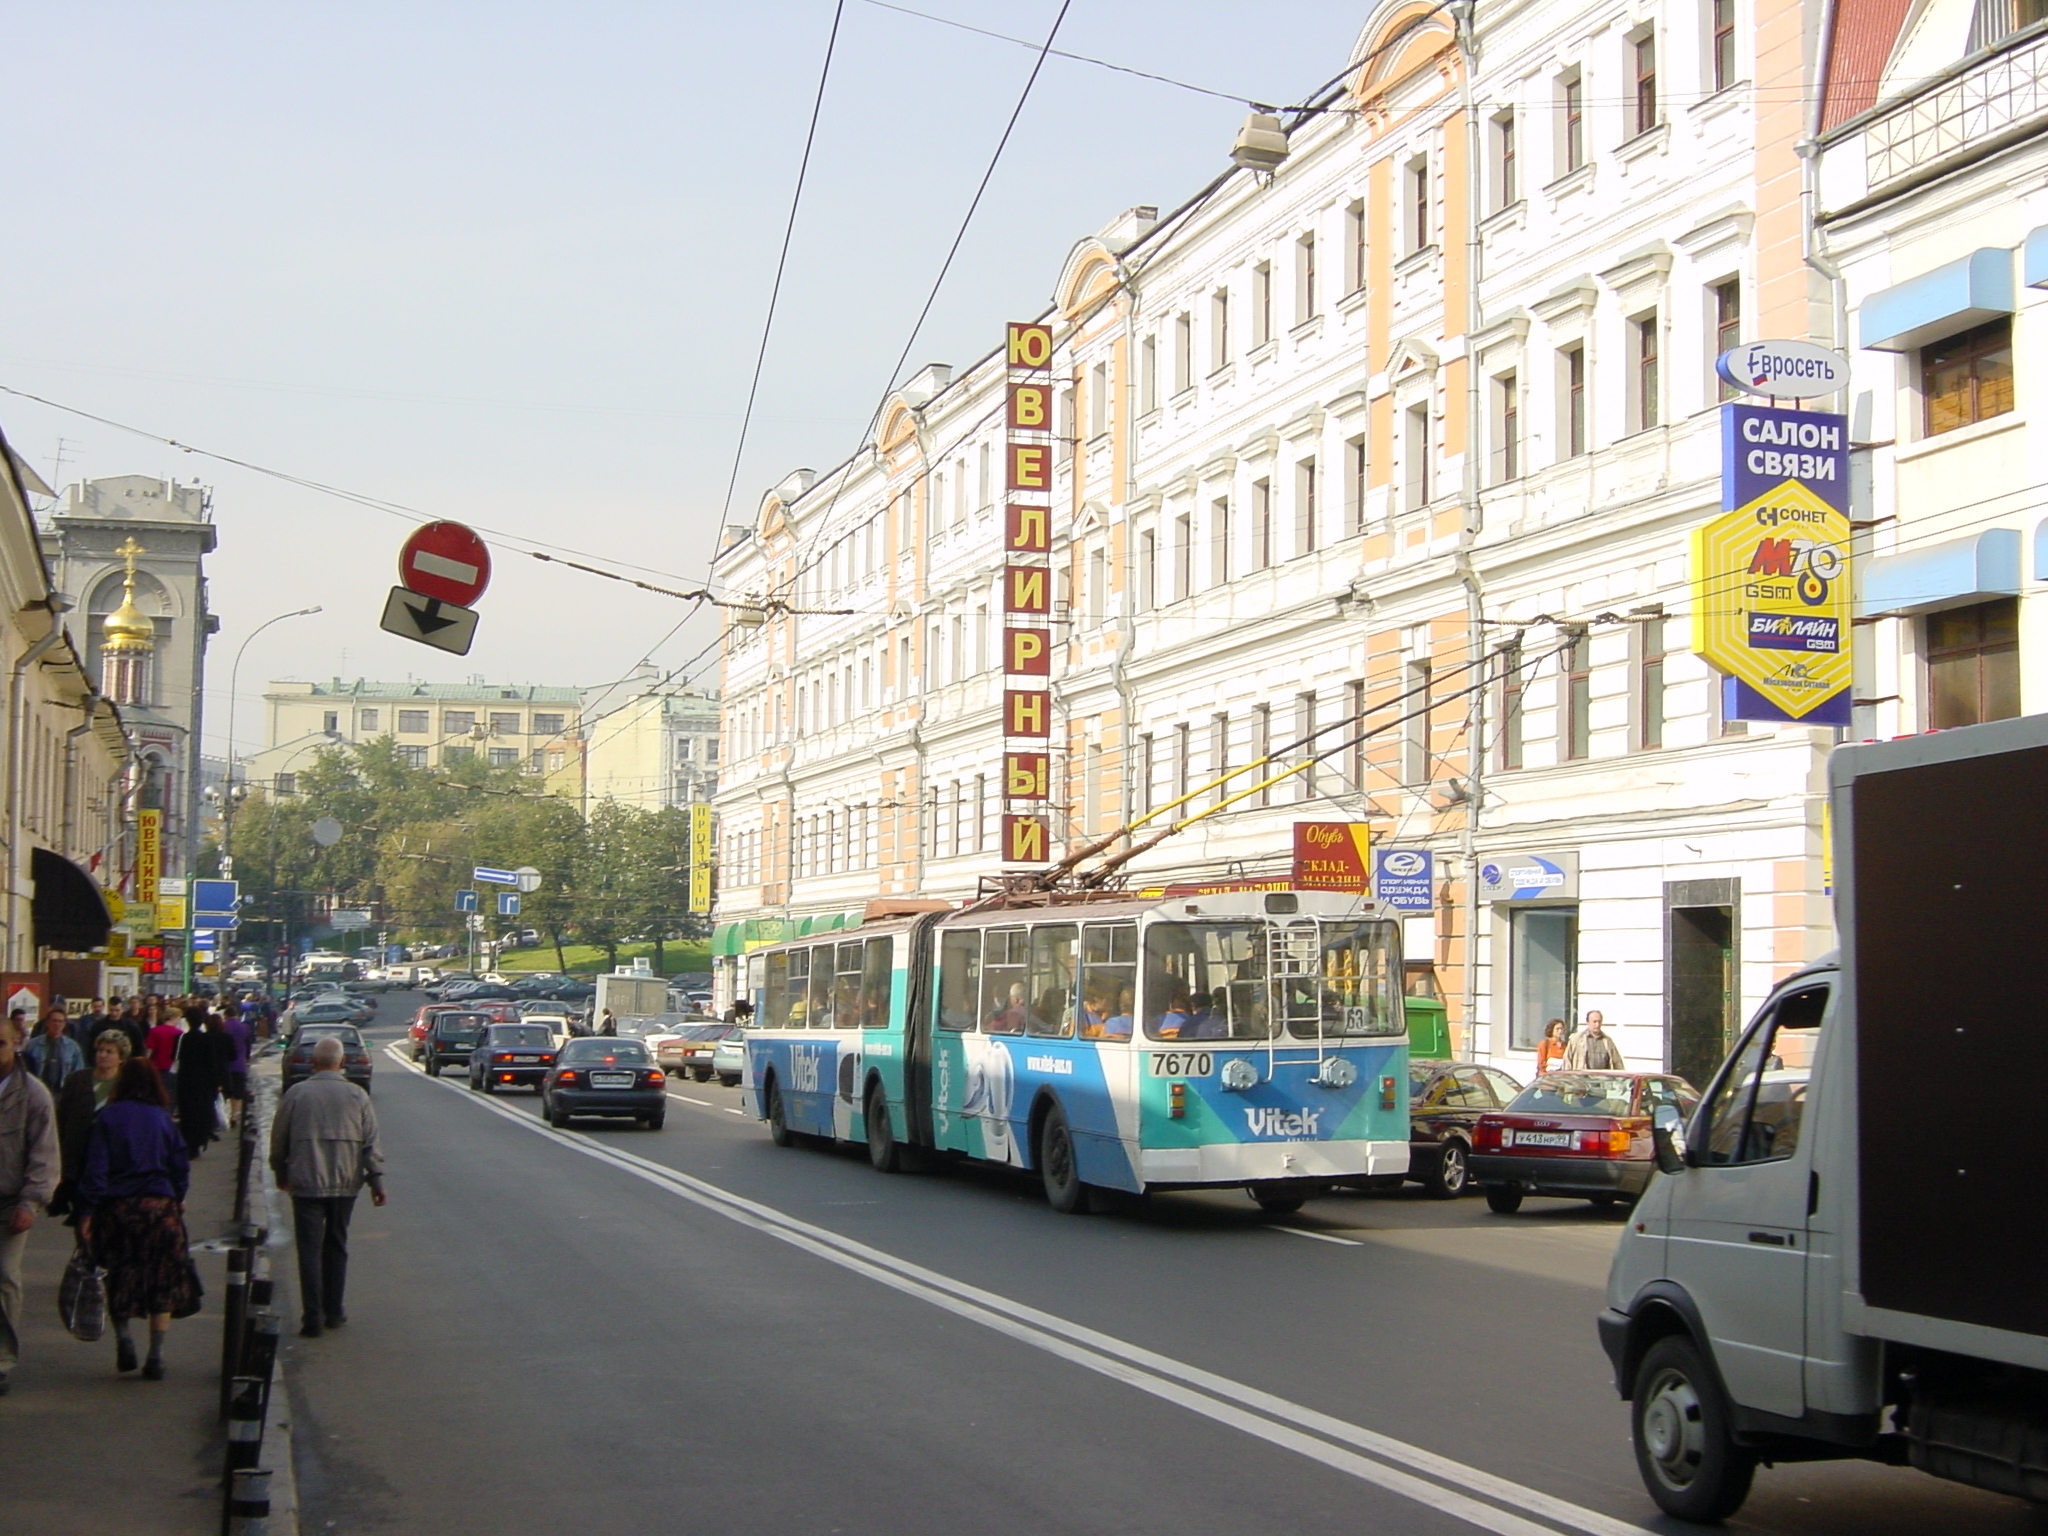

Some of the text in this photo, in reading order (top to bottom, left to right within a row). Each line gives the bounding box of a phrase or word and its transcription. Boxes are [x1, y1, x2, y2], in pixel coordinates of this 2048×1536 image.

[1747, 345, 1835, 381] Евросеть
[1743, 417, 1839, 451] САЛОН
[1747, 449, 1835, 481] СВЯЗИ
[1780, 508, 1827, 523] СОНЕТ
[1747, 537, 1844, 581] МТС
[1009, 326, 1051, 860] ЮВЕЛИРНЫЙ
[1746, 584, 1792, 600] GSM
[1806, 639, 1835, 649] GSM
[1306, 825, 1344, 849] Обувь
[1380, 886, 1430, 895] ОДЕЖДА
[1391, 896, 1430, 905] ОБУВЬ
[1347, 1009, 1364, 1030] 63
[789, 1044, 821, 1093] Vitek
[1152, 1053, 1211, 1076] 7670
[1243, 1107, 1318, 1137] Vitek
